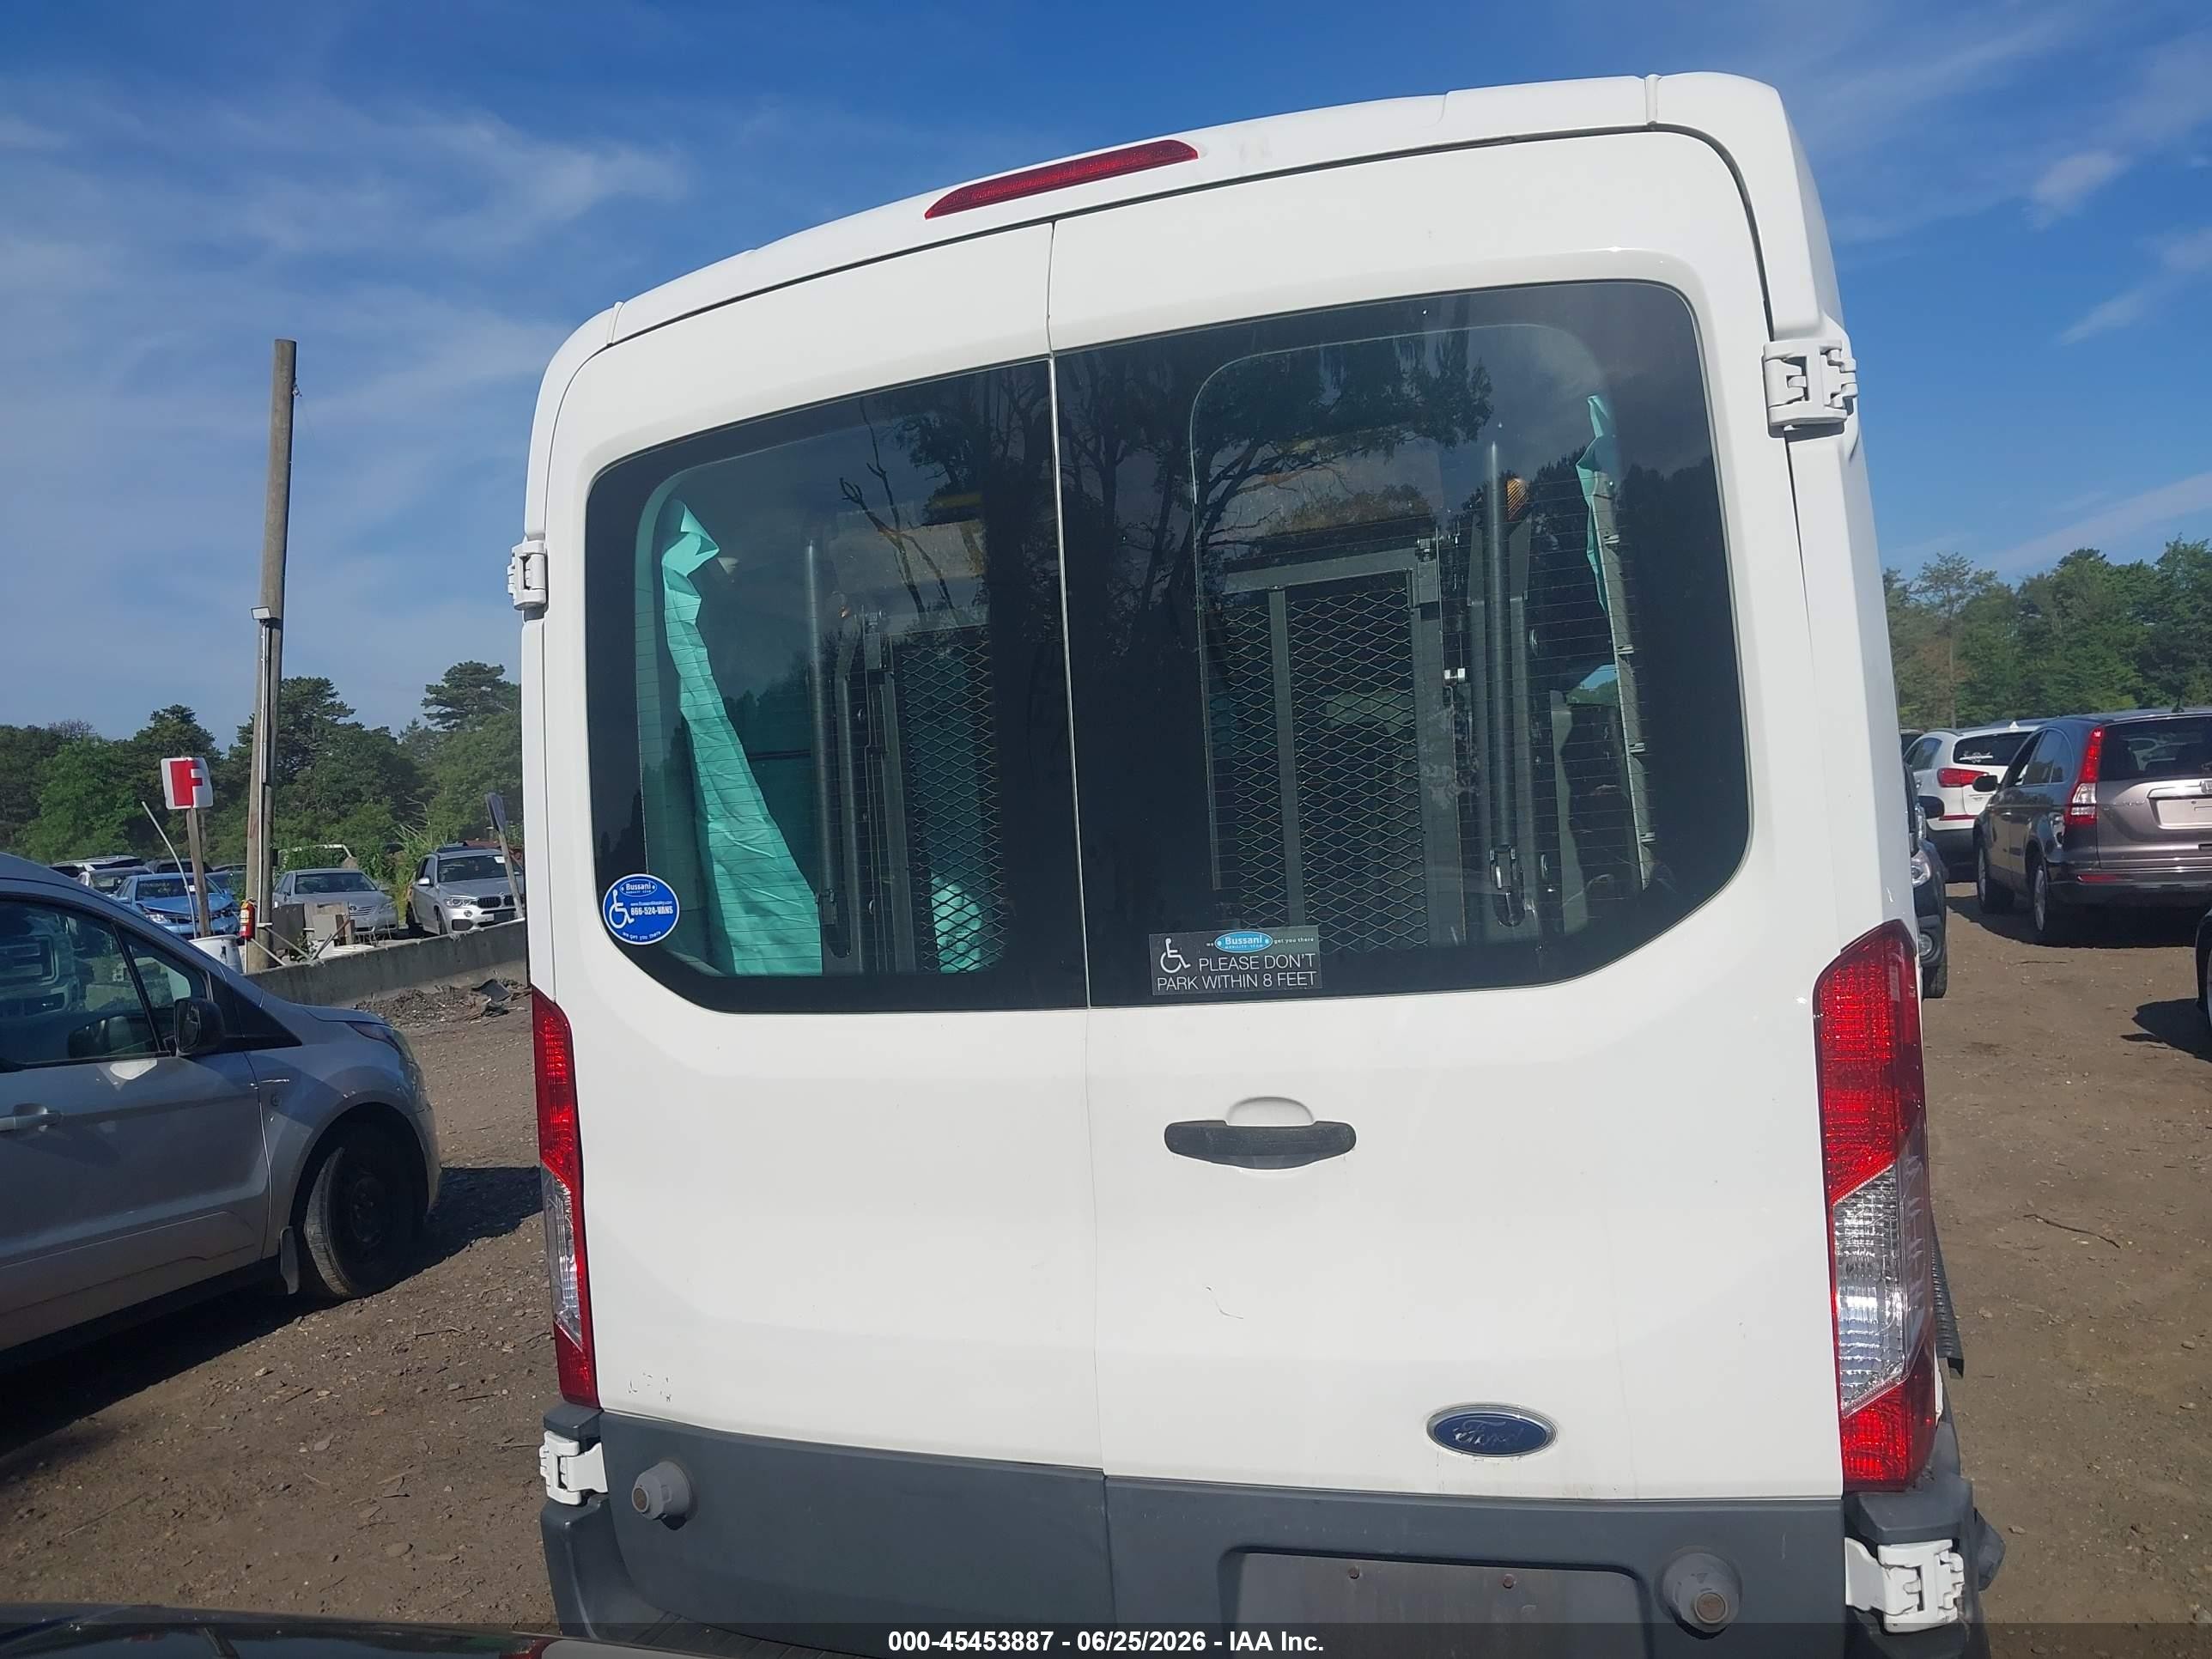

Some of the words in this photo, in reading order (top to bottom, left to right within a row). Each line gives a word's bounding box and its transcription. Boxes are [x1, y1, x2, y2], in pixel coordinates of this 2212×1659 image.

[170, 761, 204, 807] F
[625, 882, 651, 890] Bussani
[630, 906, 674, 915] 866-524-VANS
[1224, 935, 1263, 945] Bussani
[1199, 956, 1260, 972] PLEASE
[1264, 953, 1316, 969] DON'T
[1157, 975, 1198, 991] PARK
[1201, 974, 1258, 990] WITHIN
[1262, 973, 1273, 988] 8
[1277, 971, 1317, 987] FEET
[1453, 1419, 1525, 1446] Ford
